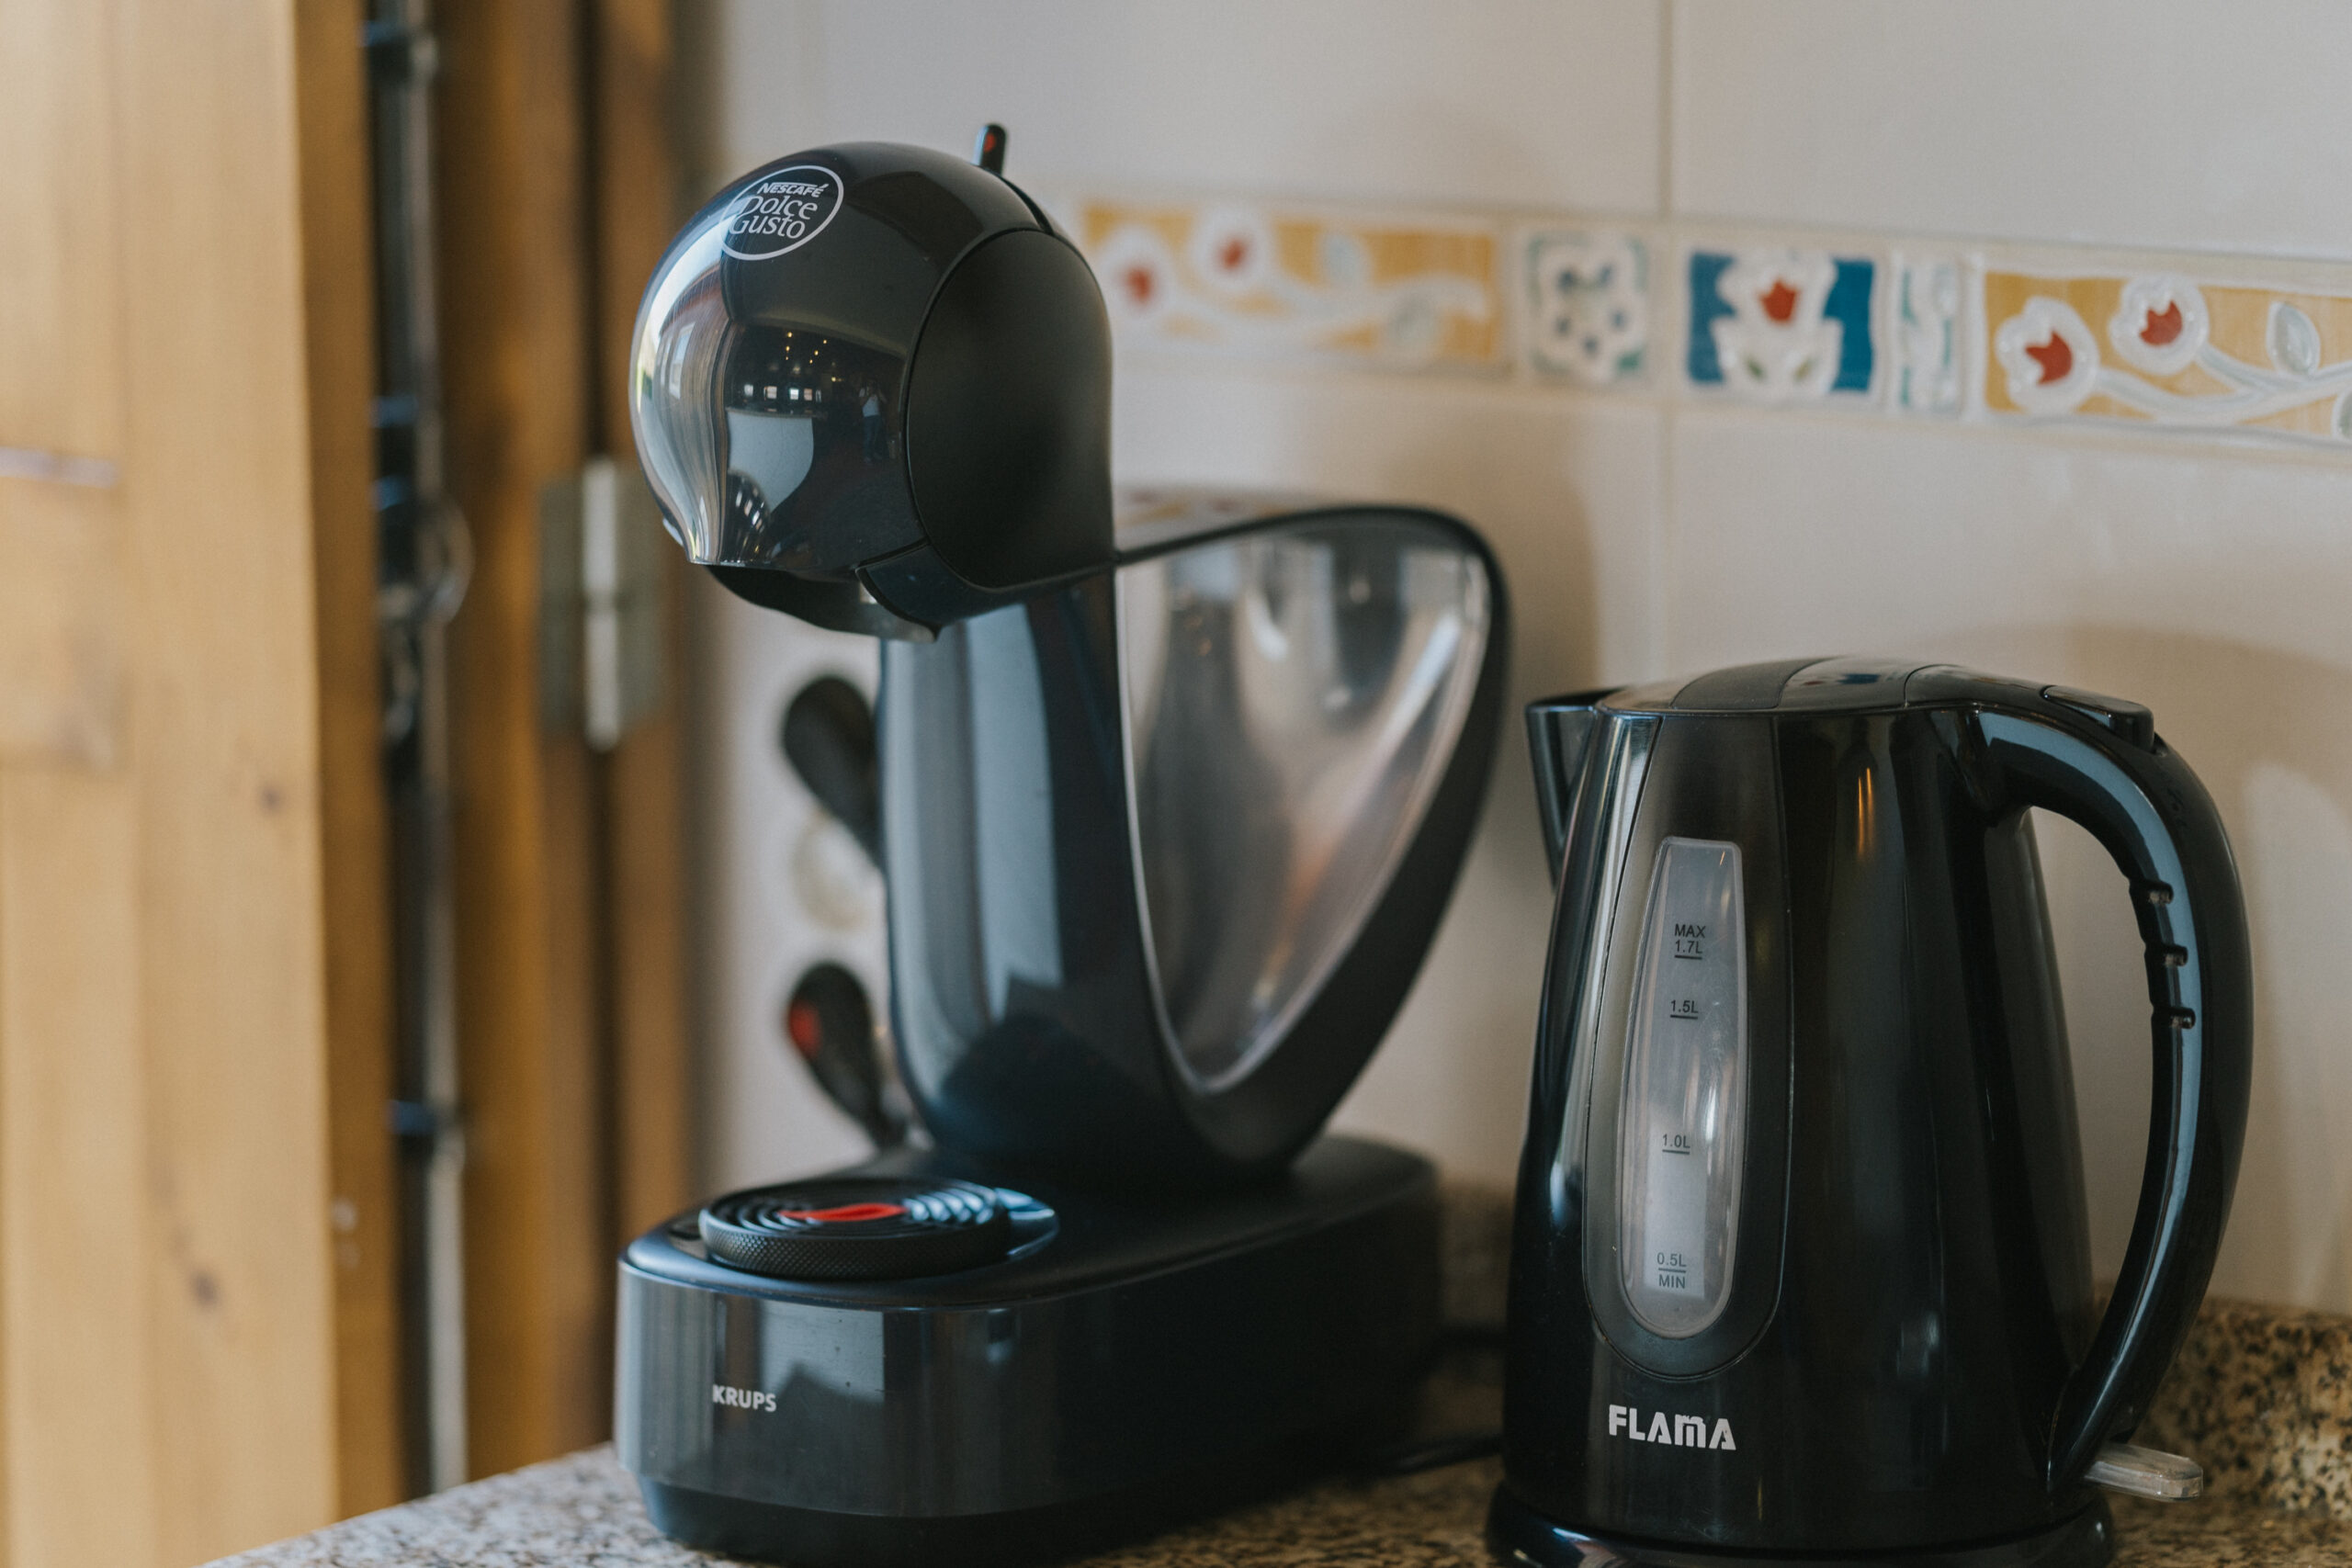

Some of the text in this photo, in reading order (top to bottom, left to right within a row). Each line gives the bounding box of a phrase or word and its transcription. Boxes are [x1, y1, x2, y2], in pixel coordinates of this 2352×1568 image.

[739, 195, 819, 220] Dolce
[729, 214, 806, 239] Gusto
[1674, 923, 1706, 938] MAX
[1675, 940, 1702, 953] 1.7L
[1670, 999, 1699, 1014] 1.5L
[1662, 1134, 1690, 1148] 1.0L
[1657, 1252, 1687, 1268] 0.5L
[1658, 1274, 1686, 1289] MIN
[712, 1384, 777, 1413] KRUPS
[1609, 1404, 1736, 1450] FLAMA
